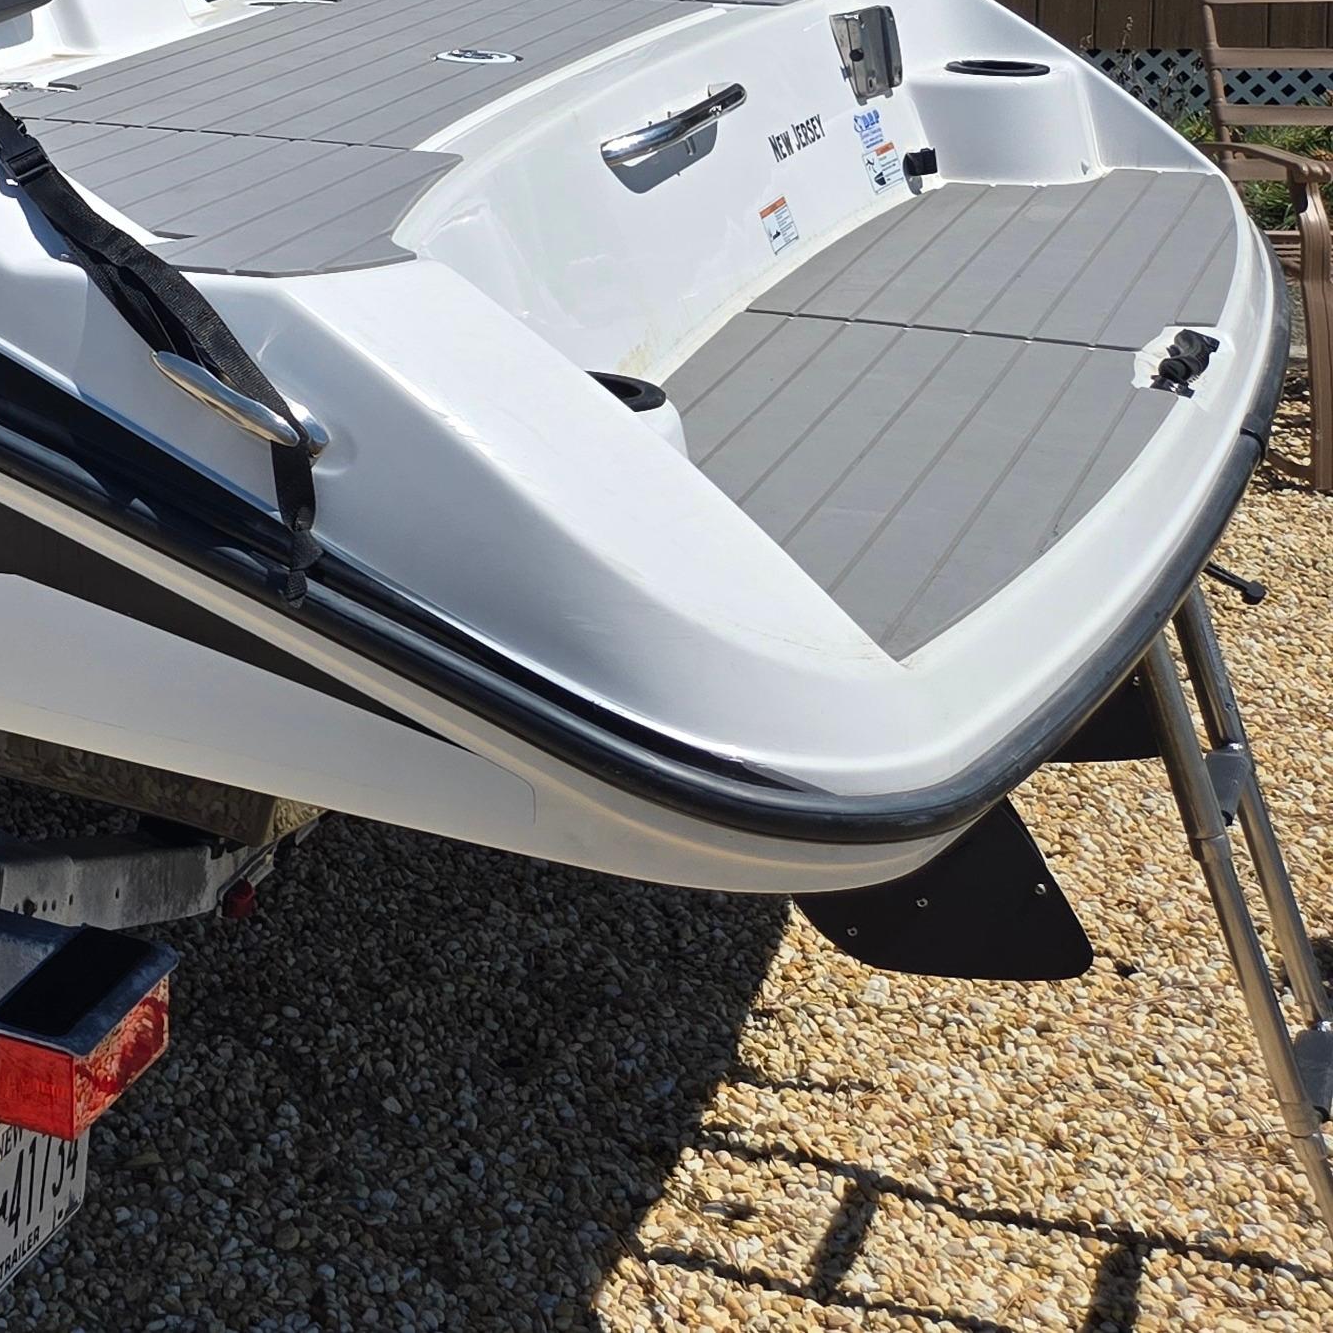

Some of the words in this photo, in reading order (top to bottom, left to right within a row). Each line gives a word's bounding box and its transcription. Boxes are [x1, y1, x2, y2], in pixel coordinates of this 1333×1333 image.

[768, 130, 795, 163] NEW
[790, 113, 826, 151] JERSEY
[0, 1226, 41, 1280] TRAILER
